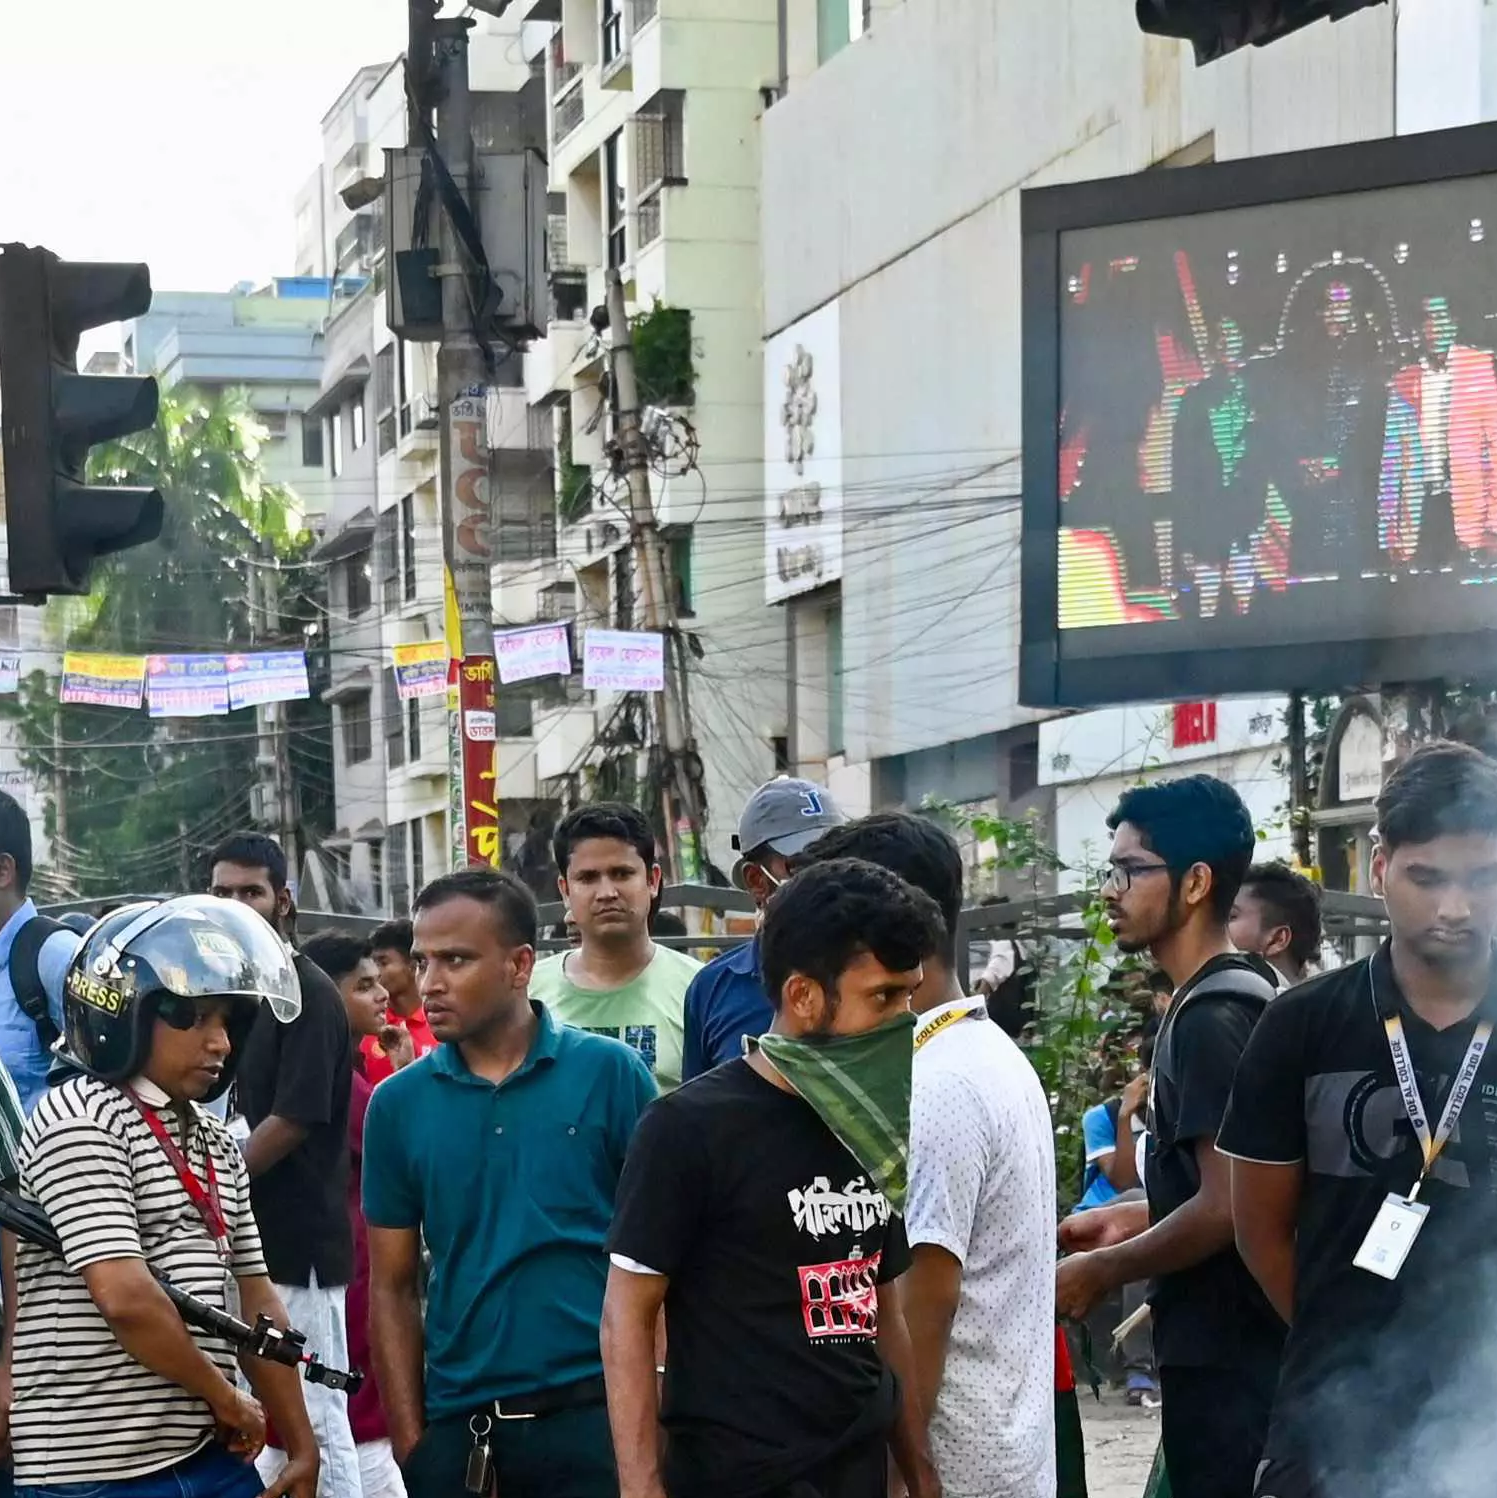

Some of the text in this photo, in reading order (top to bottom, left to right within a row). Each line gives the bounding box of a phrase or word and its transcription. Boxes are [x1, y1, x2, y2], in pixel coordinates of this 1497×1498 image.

[799, 790, 823, 816] J
[70, 970, 121, 1012] PRESS
[915, 1010, 955, 1044] COLLEGE
[1390, 1038, 1419, 1116] IDEAL COLLEGE
[1443, 1052, 1480, 1129] IDEAL COLLEGE
